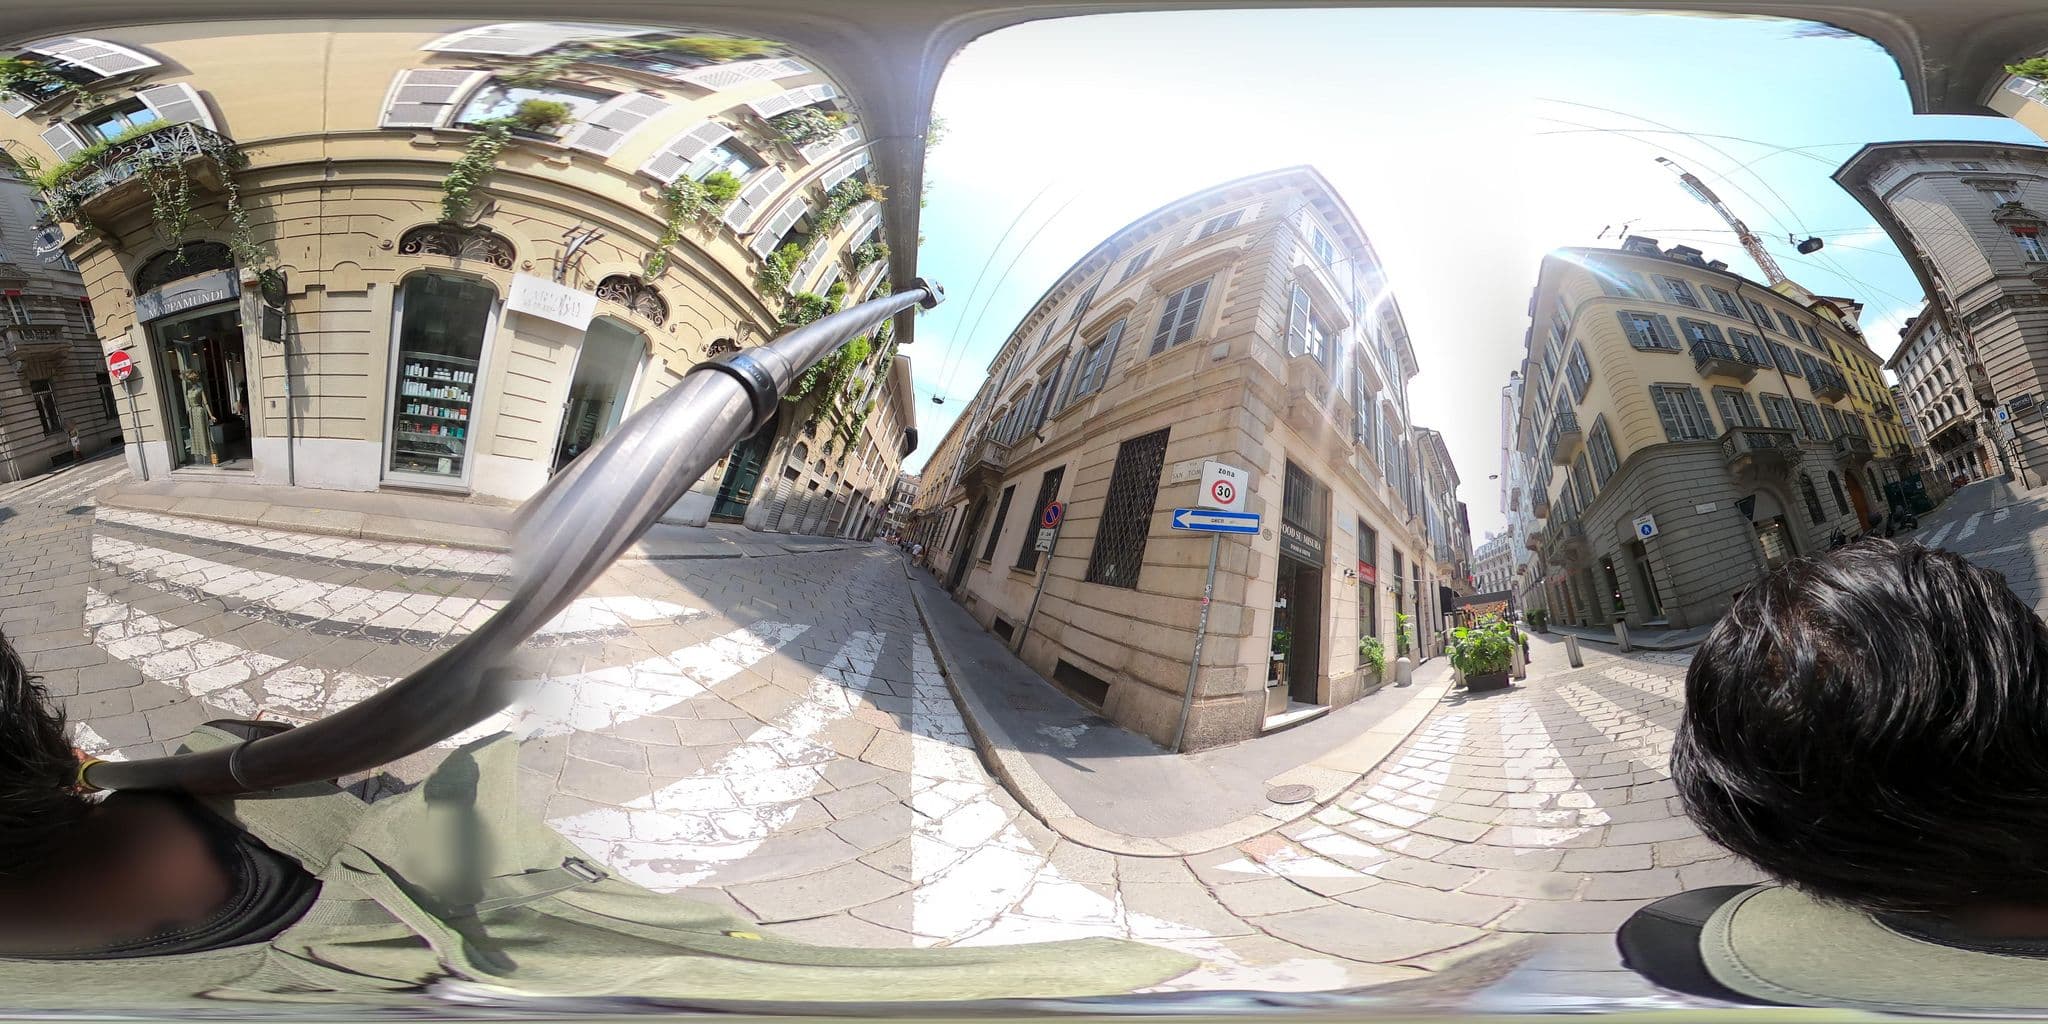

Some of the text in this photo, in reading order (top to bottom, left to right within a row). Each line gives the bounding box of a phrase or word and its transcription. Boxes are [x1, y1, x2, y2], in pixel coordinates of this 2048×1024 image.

[148, 289, 223, 319] MAPPAMUNDI
[1218, 467, 1235, 478] zona
[1216, 485, 1231, 498] 30
